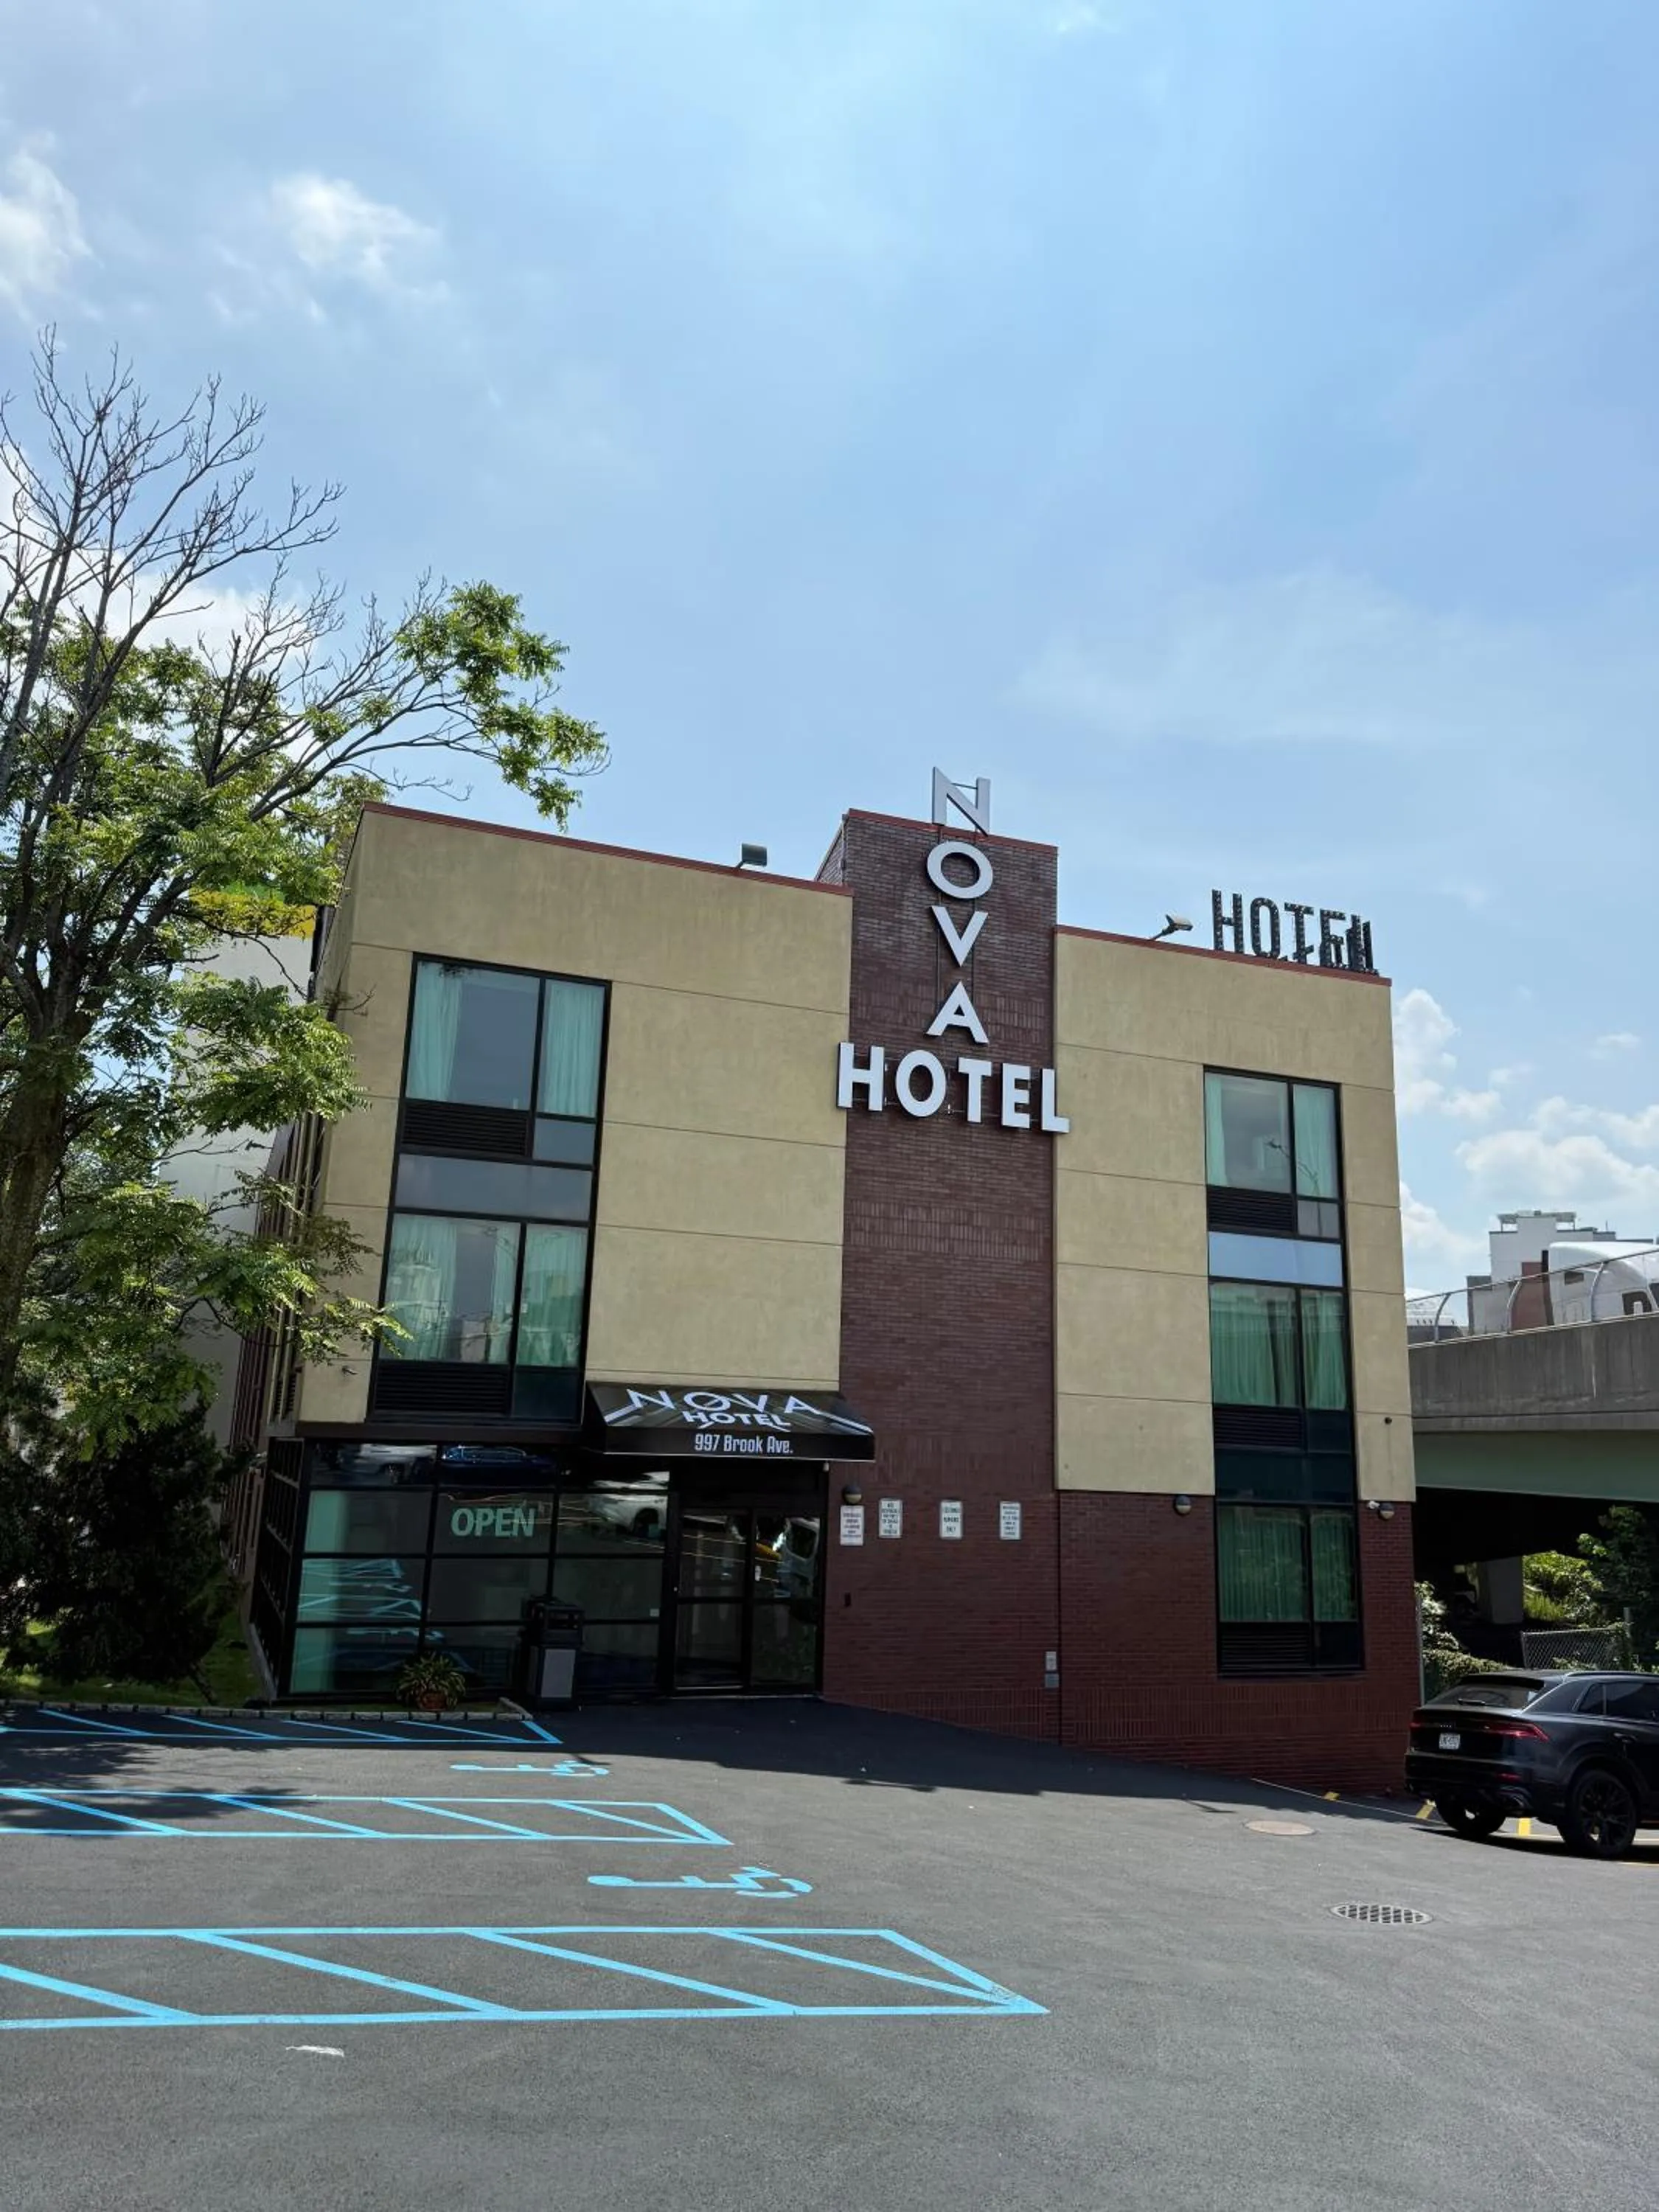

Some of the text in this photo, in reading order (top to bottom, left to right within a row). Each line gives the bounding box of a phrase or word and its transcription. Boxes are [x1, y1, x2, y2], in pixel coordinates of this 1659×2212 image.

[926, 766, 993, 1044] NOVA
[1211, 889, 1379, 975] HOTEL
[836, 1041, 1071, 1134] HOTEL
[625, 1388, 821, 1415] NOVA
[681, 1411, 791, 1427] HOTEL
[695, 1433, 793, 1454] 997 Brook Ave.
[451, 1508, 535, 1537] OPEN
